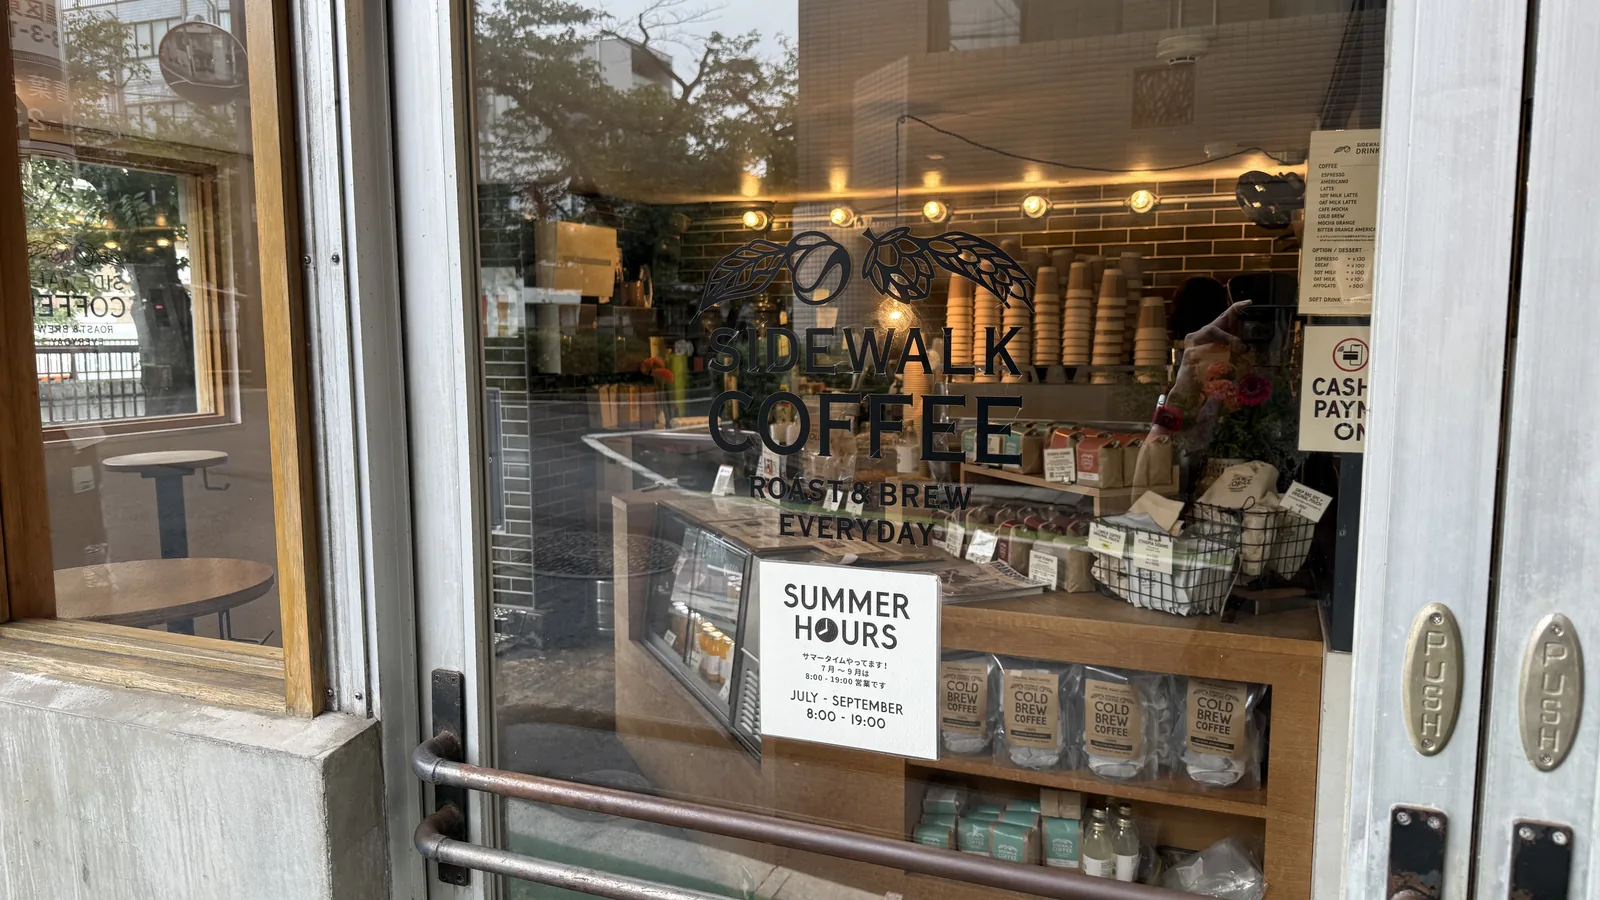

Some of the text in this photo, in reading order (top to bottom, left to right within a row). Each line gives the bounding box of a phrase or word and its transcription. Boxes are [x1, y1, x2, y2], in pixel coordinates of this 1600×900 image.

[708, 326, 1024, 378] SIDEWALK
[709, 390, 1024, 465] COFFEE
[750, 475, 844, 503] ROAST
[851, 481, 869, 505] &
[879, 482, 972, 511] BREW
[779, 513, 936, 546] EVERYDAY
[783, 583, 911, 620] SUMMER
[795, 614, 898, 650] HOURS
[805, 672, 823, 682] 8:00
[830, 675, 853, 685] 19:00
[855, 678, 887, 690] 営業です
[946, 680, 979, 694] COLD
[1421, 630, 1448, 737] PUSH
[790, 689, 819, 704] JULY
[832, 694, 904, 716] SEPTEMBER
[947, 692, 978, 705] BREW
[1014, 691, 1048, 704] COLD
[1197, 697, 1234, 713] COLD
[1539, 641, 1568, 752] PUSH
[947, 702, 978, 714] COFFEE
[1015, 702, 1048, 716] BREW
[1094, 701, 1130, 716] COLD
[1197, 708, 1232, 725] BREW
[806, 708, 836, 723] 8:00
[851, 713, 887, 729] 19:00
[1014, 713, 1047, 726] COFFEE
[1095, 712, 1129, 727] BREW
[1094, 724, 1128, 737] COFFEE
[1195, 720, 1231, 735] COFFEE
